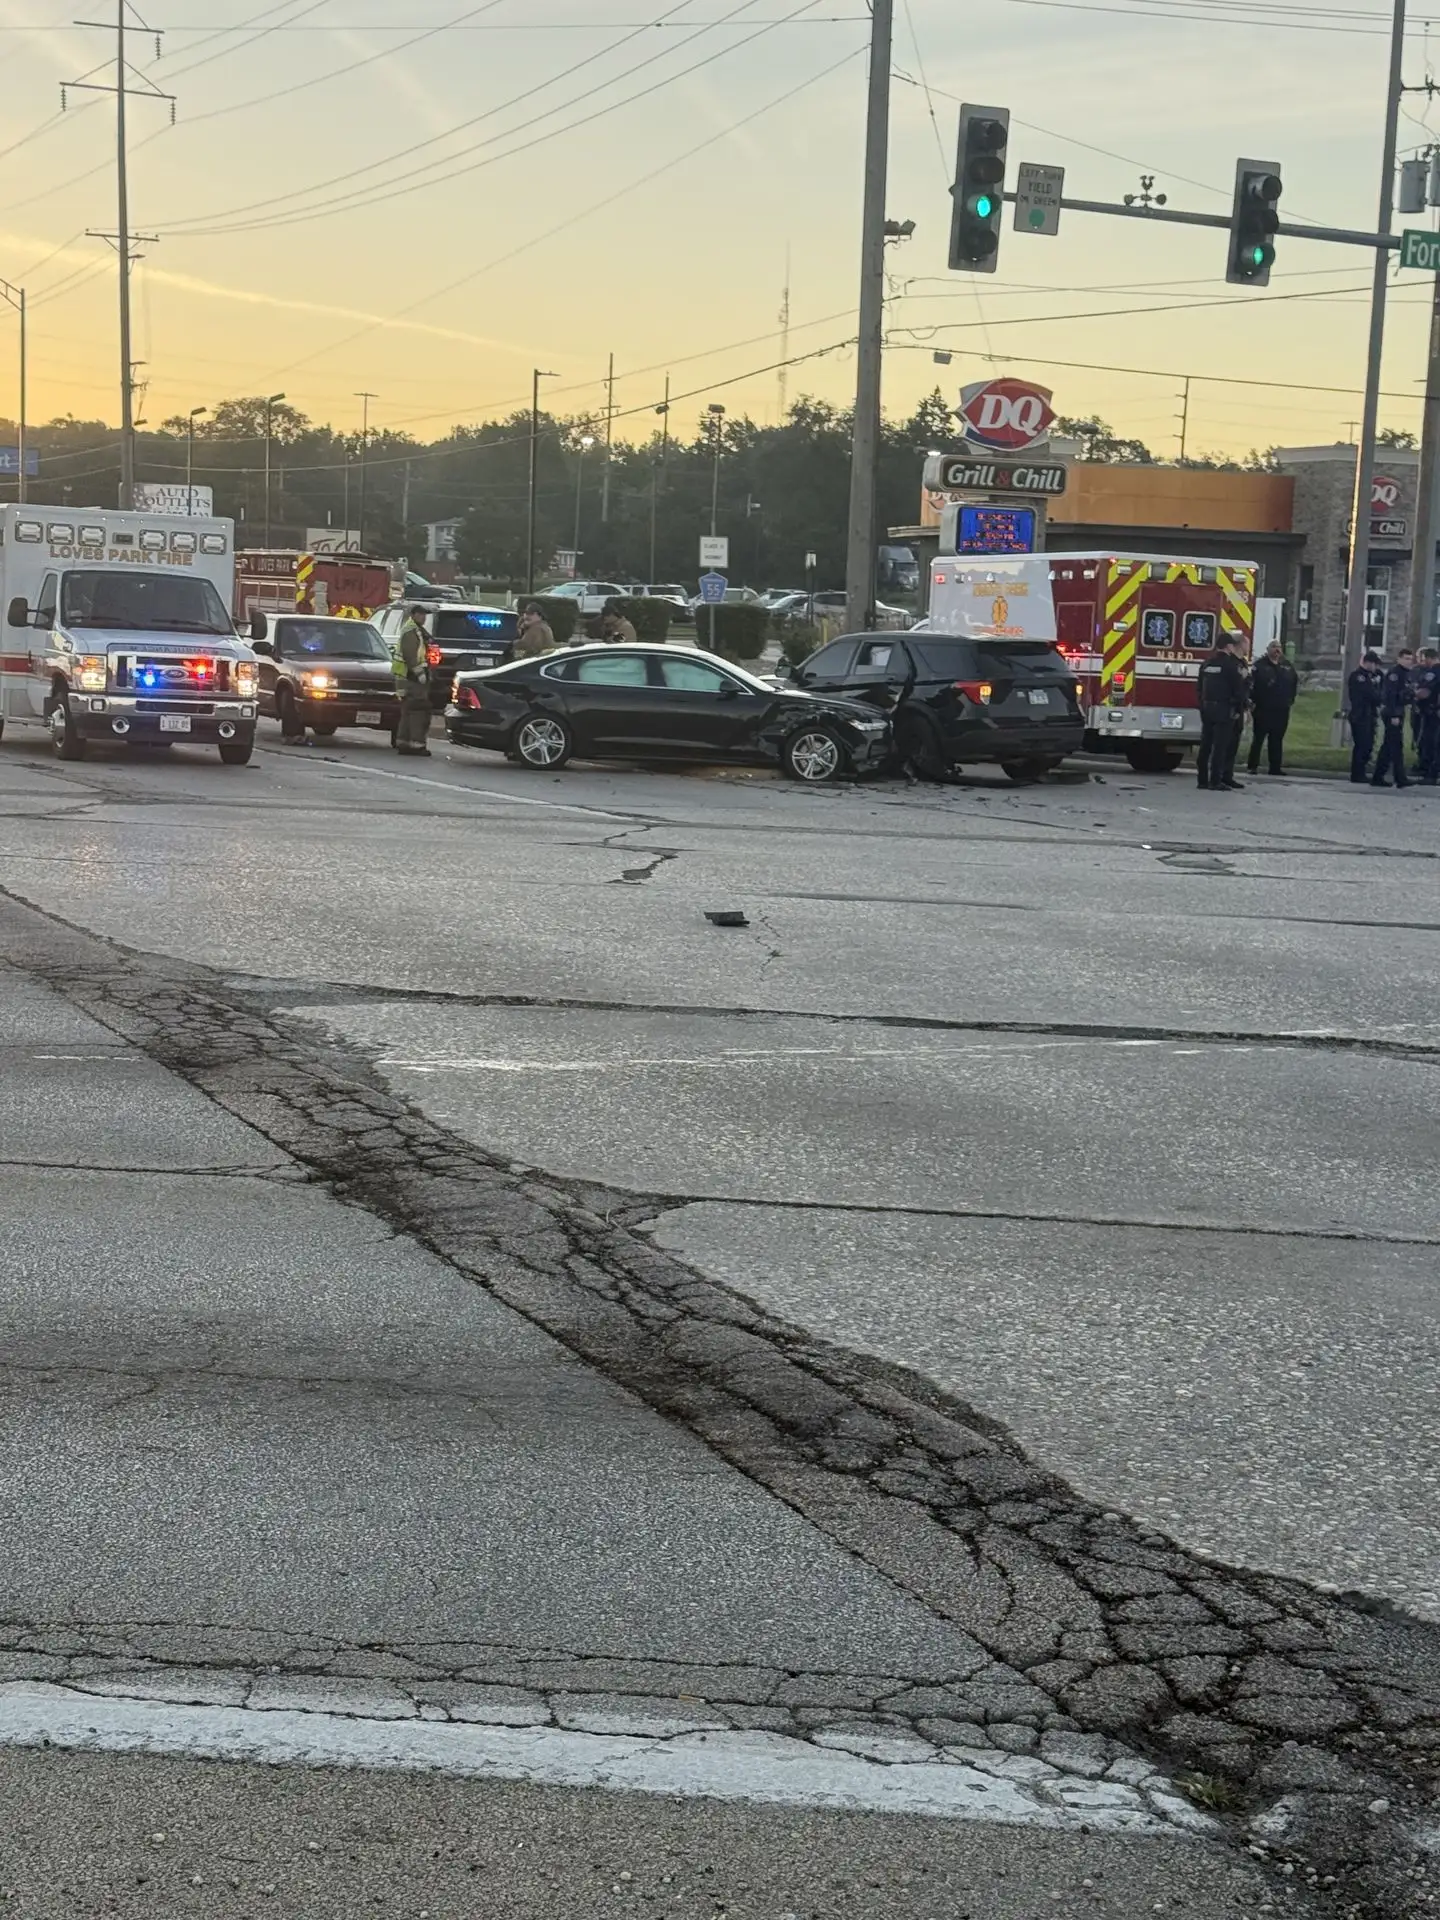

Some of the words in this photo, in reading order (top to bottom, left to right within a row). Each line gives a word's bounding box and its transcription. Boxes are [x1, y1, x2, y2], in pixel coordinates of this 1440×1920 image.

[1028, 181, 1053, 194] YIELD
[1406, 234, 1440, 267] For
[977, 394, 1043, 437] DQ
[947, 464, 996, 487] Grill
[997, 470, 1011, 488] &
[1012, 468, 1062, 491] Chill
[156, 488, 199, 498] AUTO
[144, 496, 211, 508] OUTLETS
[1379, 522, 1405, 534] Chill
[50, 545, 104, 561] LOVES
[109, 549, 153, 564] PARK
[157, 551, 193, 567] FIRE
[707, 583, 721, 596] 55
